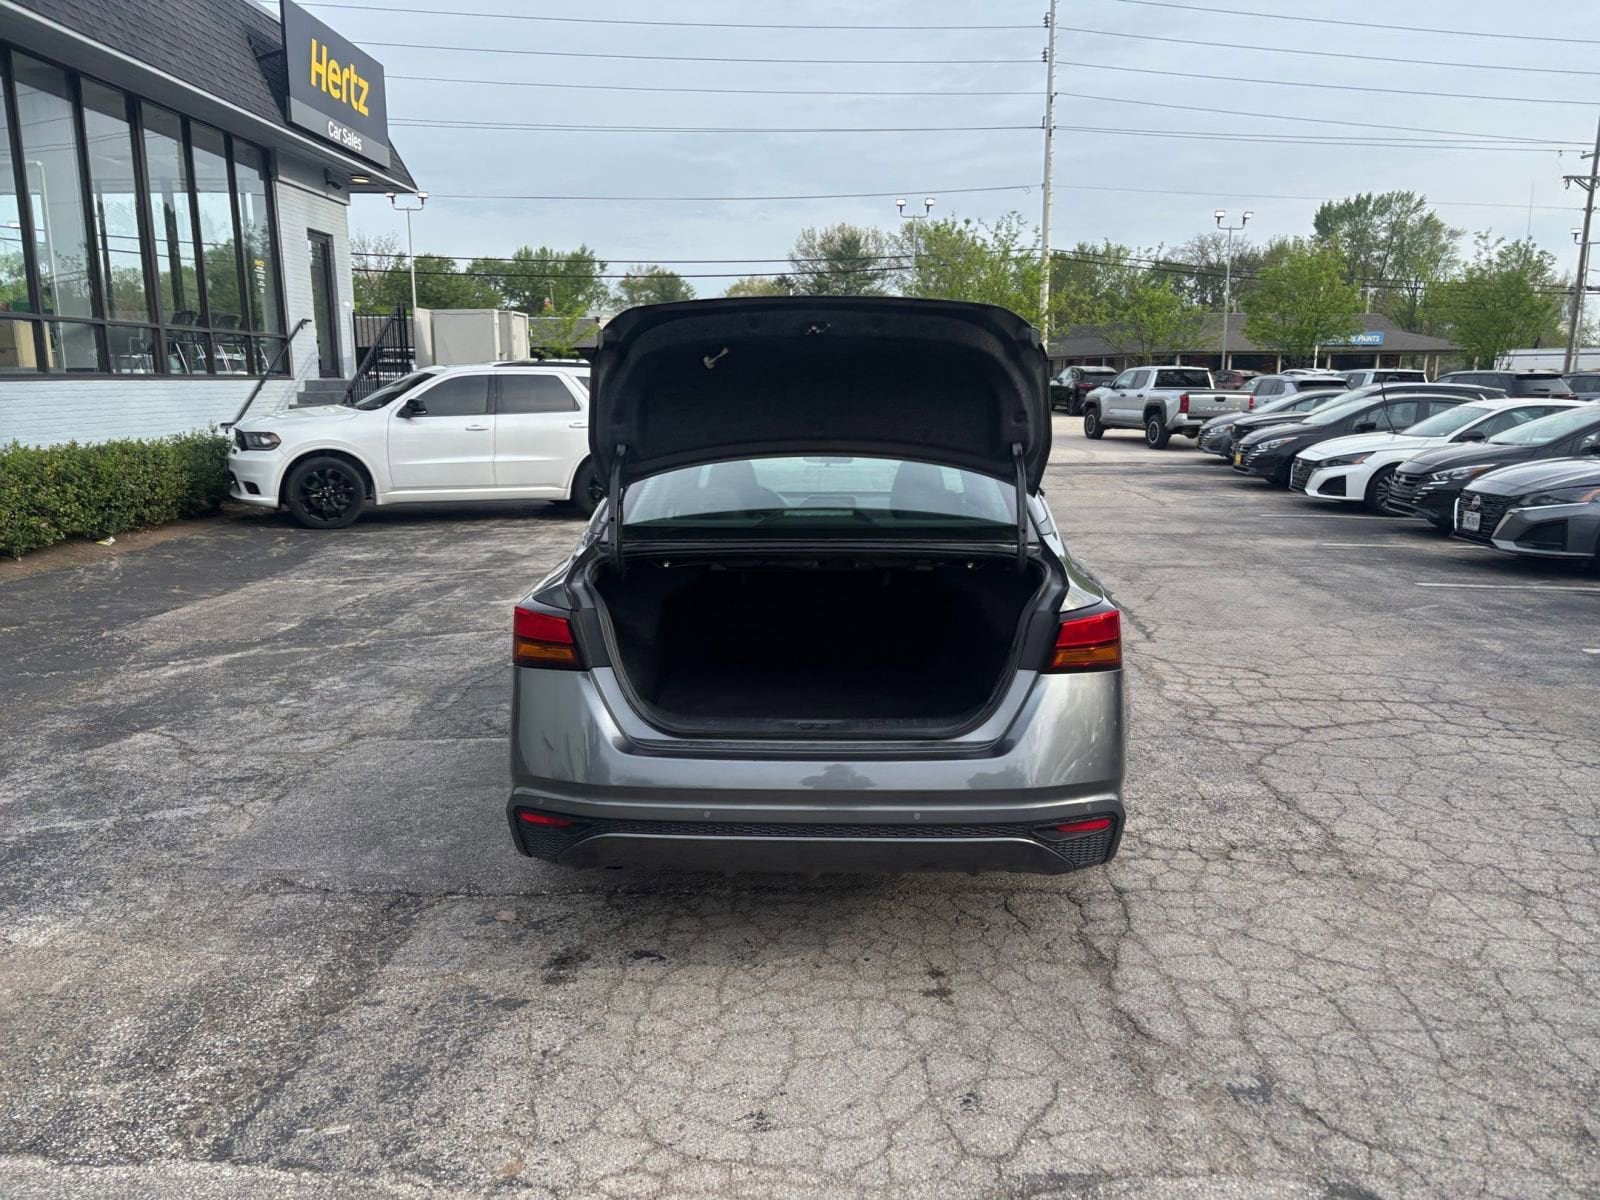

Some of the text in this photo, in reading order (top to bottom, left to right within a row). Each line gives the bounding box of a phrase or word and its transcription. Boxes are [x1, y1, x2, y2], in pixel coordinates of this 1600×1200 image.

[310, 38, 369, 117] Hertz
[328, 120, 362, 151] Car Sales
